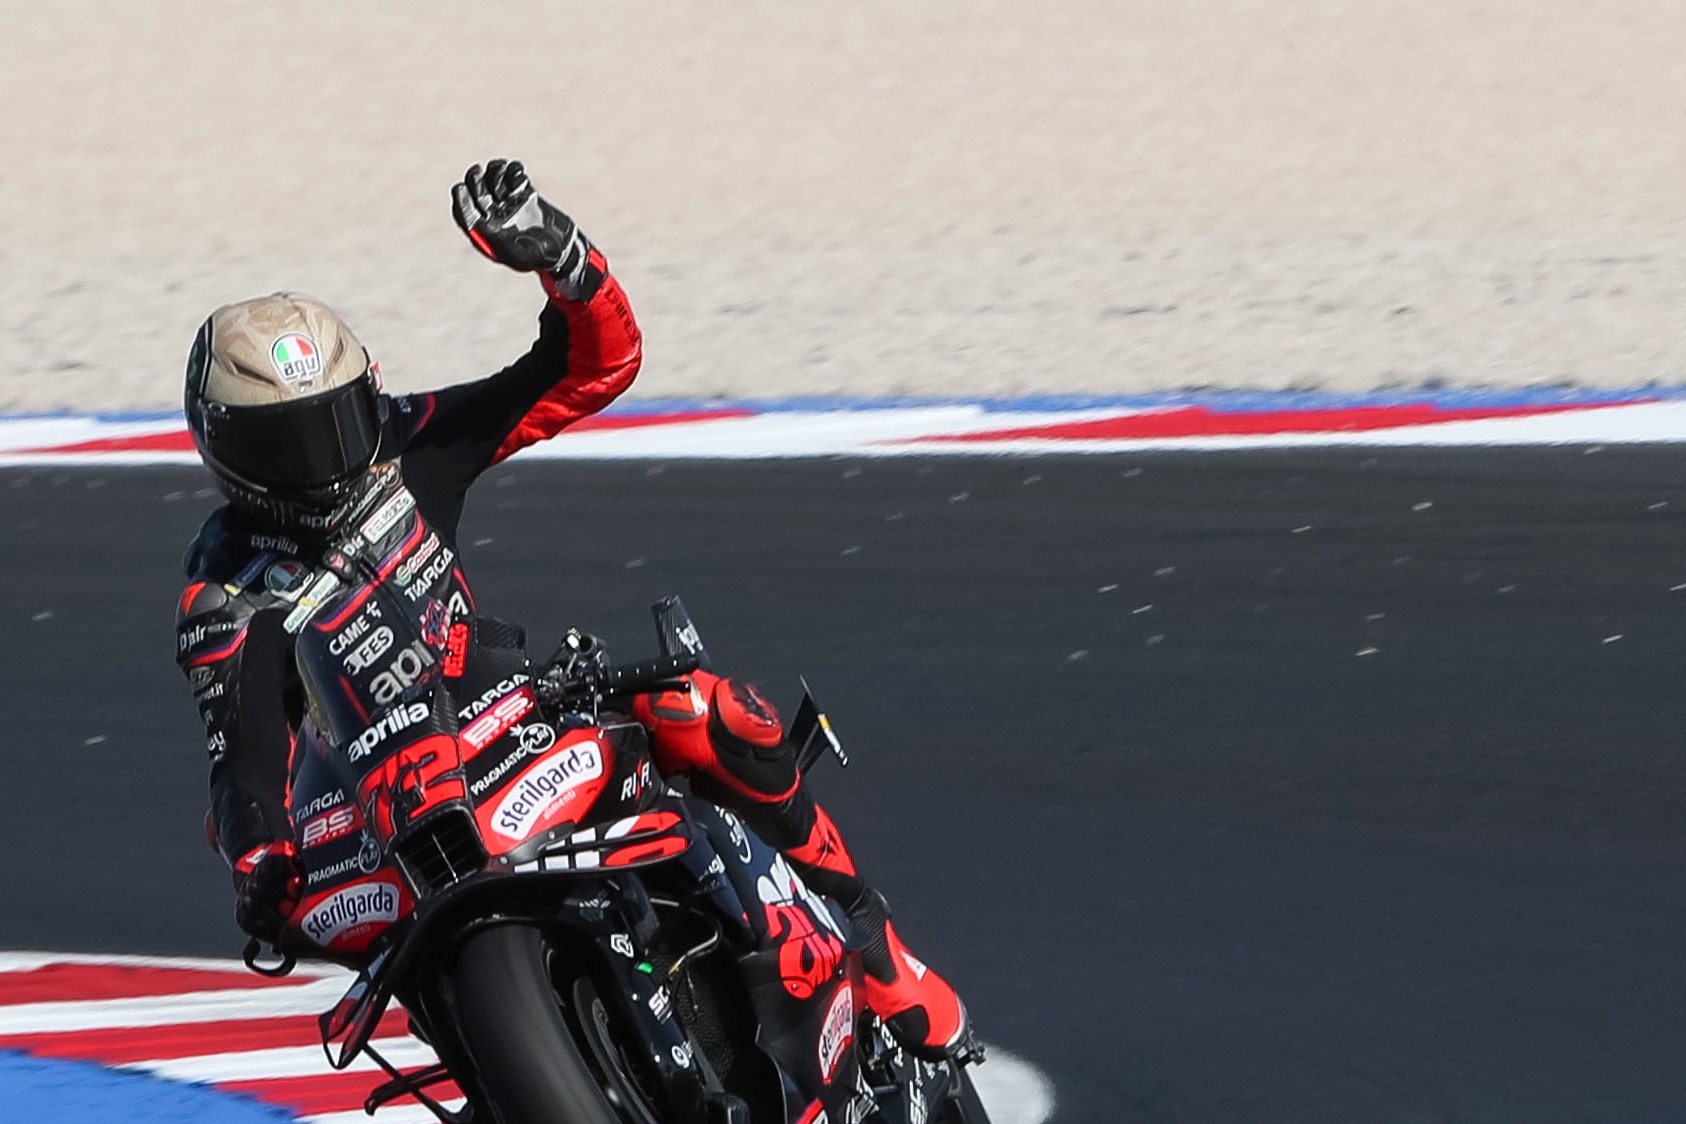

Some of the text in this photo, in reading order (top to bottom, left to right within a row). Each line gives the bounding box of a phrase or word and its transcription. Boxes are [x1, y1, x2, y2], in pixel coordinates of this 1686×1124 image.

[284, 357, 315, 377] agv
[251, 535, 298, 555] aprilia
[404, 547, 454, 601] TARGA
[329, 614, 370, 656] CAME
[457, 673, 530, 720] TARGA
[462, 690, 528, 746] BS
[348, 702, 430, 763] aprilia
[358, 733, 466, 844] 72
[470, 746, 527, 796] PRAGMATIC
[500, 748, 595, 832] sterilgarda
[296, 788, 345, 824] TARGA
[303, 806, 354, 844] BS
[308, 857, 358, 886] PRAGMATIC
[307, 884, 394, 940] sterilgarda
